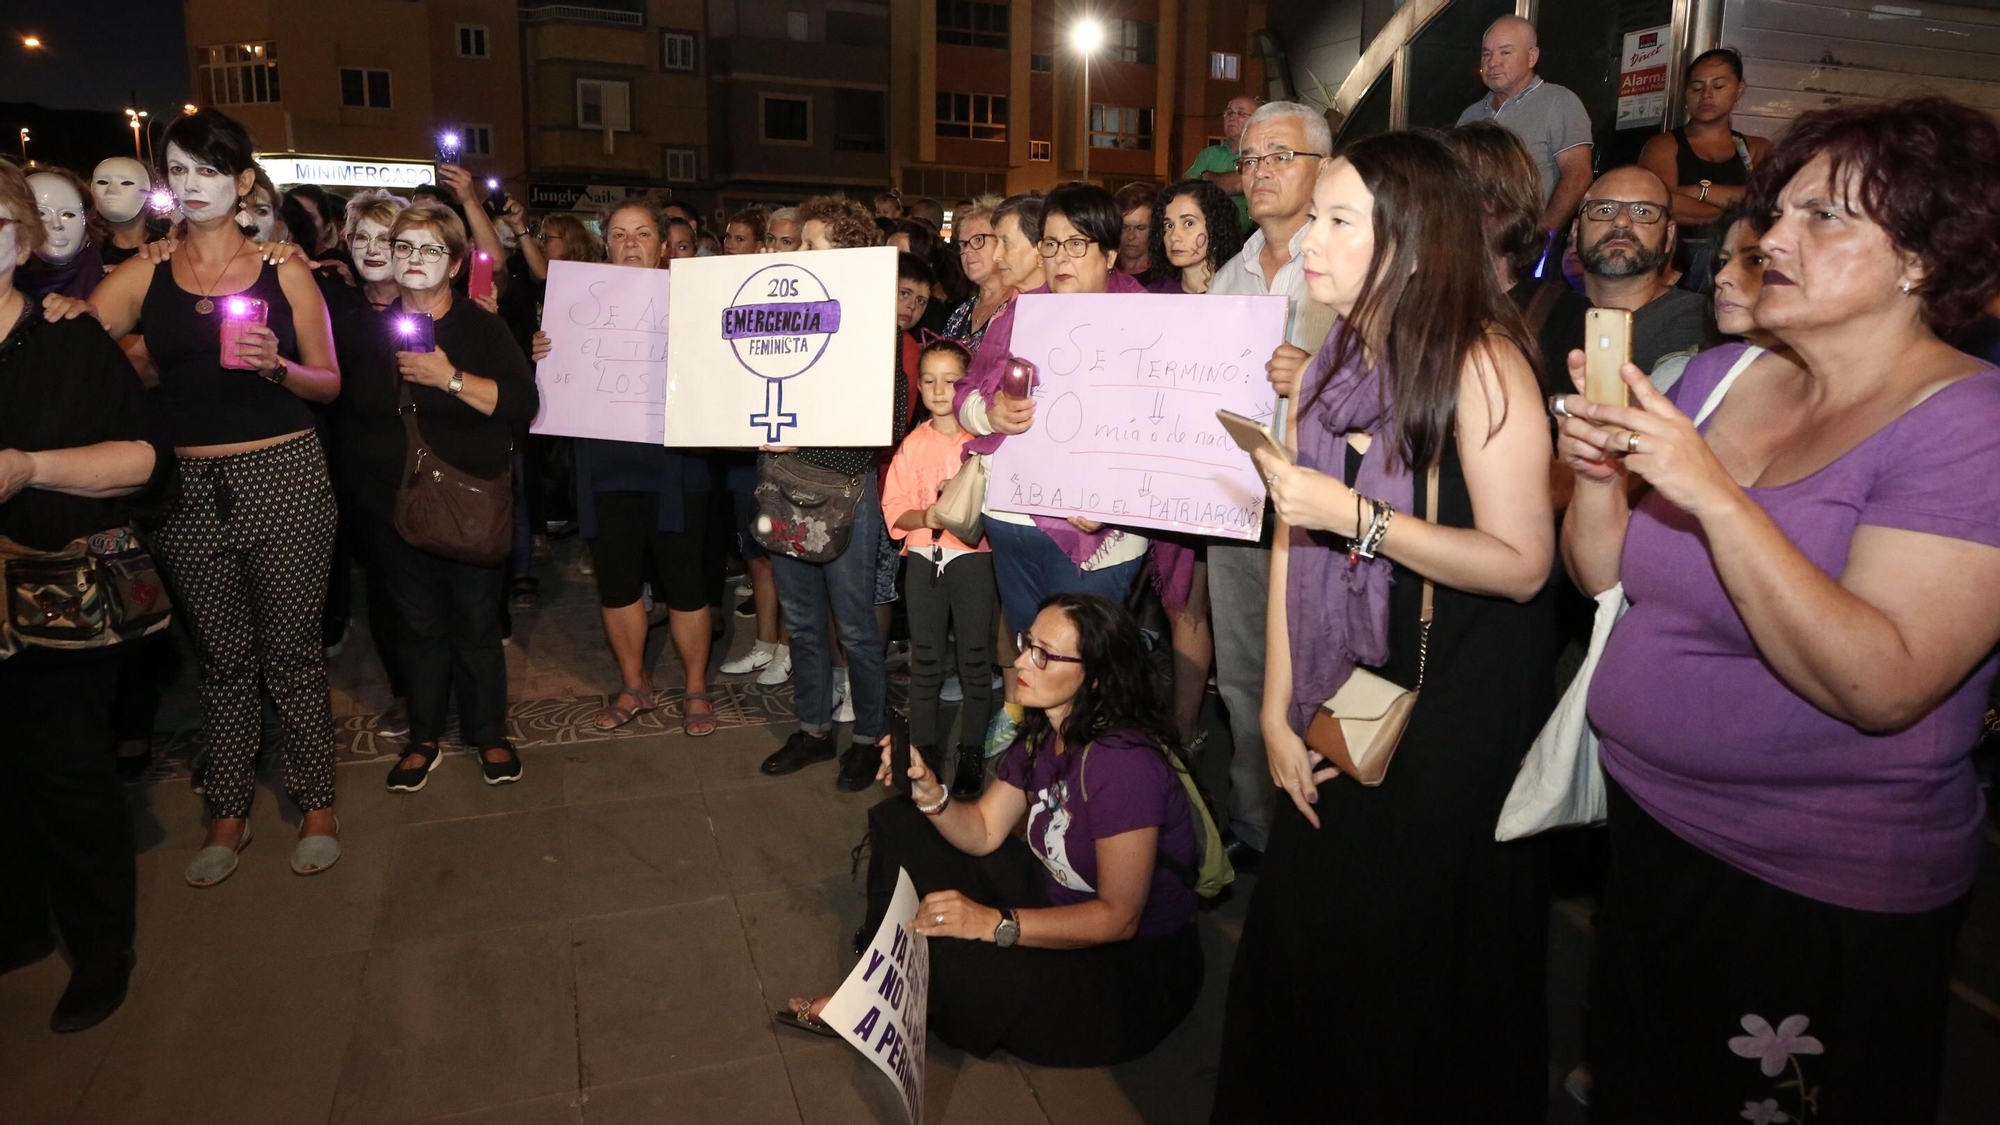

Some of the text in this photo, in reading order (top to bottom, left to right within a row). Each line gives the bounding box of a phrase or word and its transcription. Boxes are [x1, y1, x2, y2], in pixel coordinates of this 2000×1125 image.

[295, 163, 433, 185] MINIMERCADO
[531, 186, 580, 205] Jungle
[568, 280, 620, 329] SE
[580, 337, 612, 360] EL
[749, 336, 809, 356] FEMINISTA
[1047, 323, 1106, 377] SE
[553, 372, 571, 385] DE
[595, 366, 651, 396] LOS
[1112, 499, 1130, 516] EL
[890, 922, 909, 970] YA
[861, 947, 885, 983] Y
[877, 963, 905, 1012] NO
[852, 1005, 882, 1044] A
